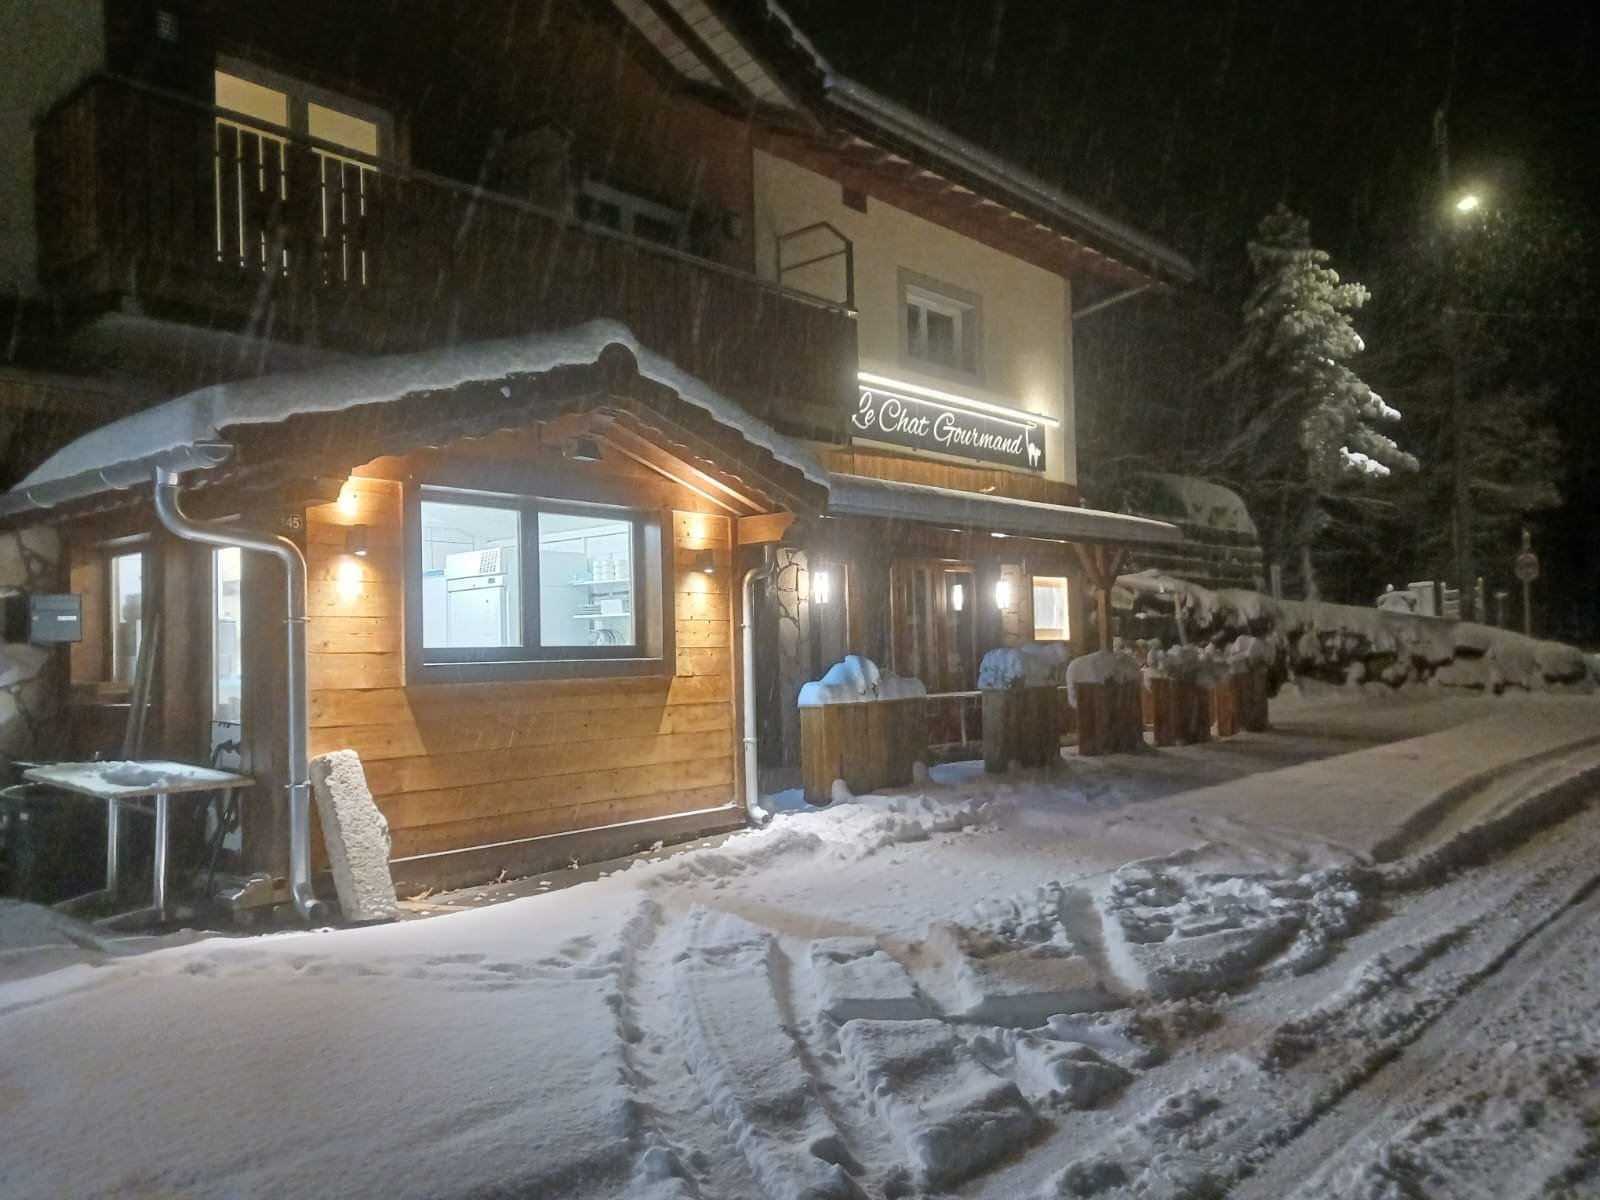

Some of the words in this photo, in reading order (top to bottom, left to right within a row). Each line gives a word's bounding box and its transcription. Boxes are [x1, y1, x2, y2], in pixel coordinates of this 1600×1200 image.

[851, 391, 876, 430] Le
[879, 399, 930, 436] Chat
[934, 412, 1023, 455] Gourmand
